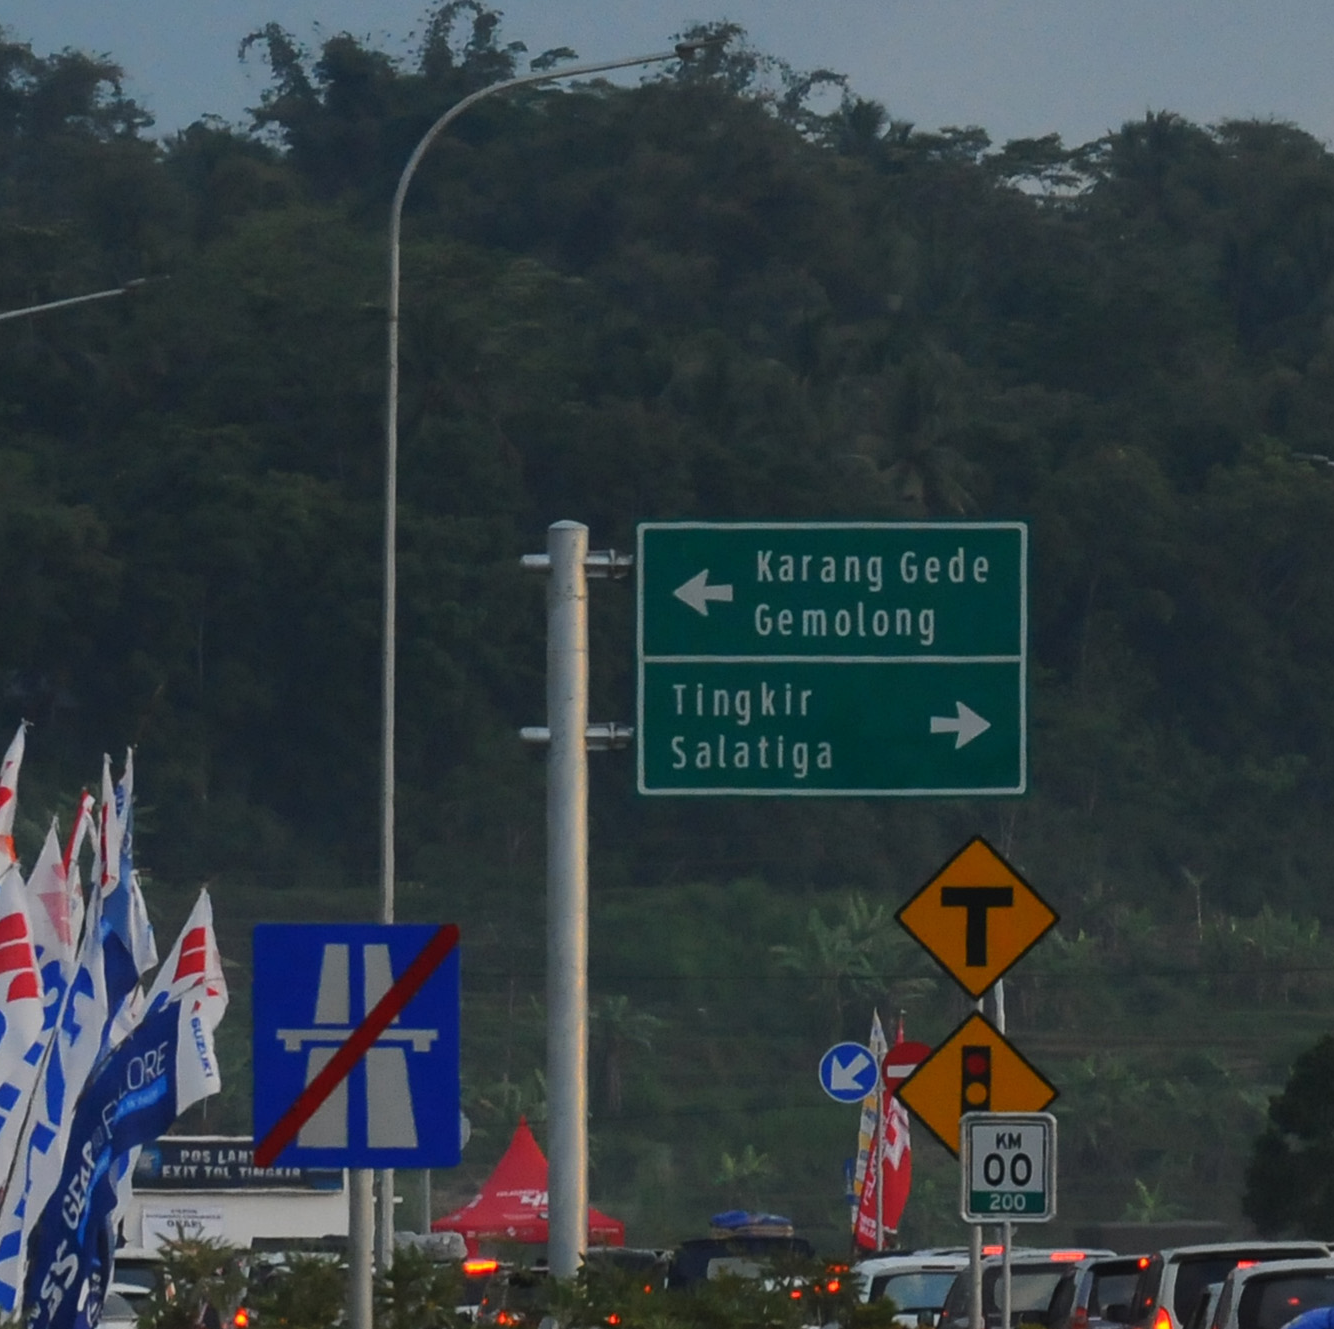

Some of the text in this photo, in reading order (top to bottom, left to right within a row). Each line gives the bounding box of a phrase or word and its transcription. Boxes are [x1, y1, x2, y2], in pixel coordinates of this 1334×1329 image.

[757, 548, 990, 592] Karang Gede
[756, 602, 936, 646] Gemolong
[673, 683, 813, 726] Tingkir
[672, 736, 833, 778] Salatiga
[190, 1017, 214, 1079] SUZUKI
[180, 1150, 211, 1164] POS
[995, 1132, 1022, 1151] KM
[162, 1165, 198, 1178] EXIT
[204, 1165, 232, 1178] TOL
[982, 1152, 1033, 1187] 00
[988, 1193, 1027, 1212] 200
